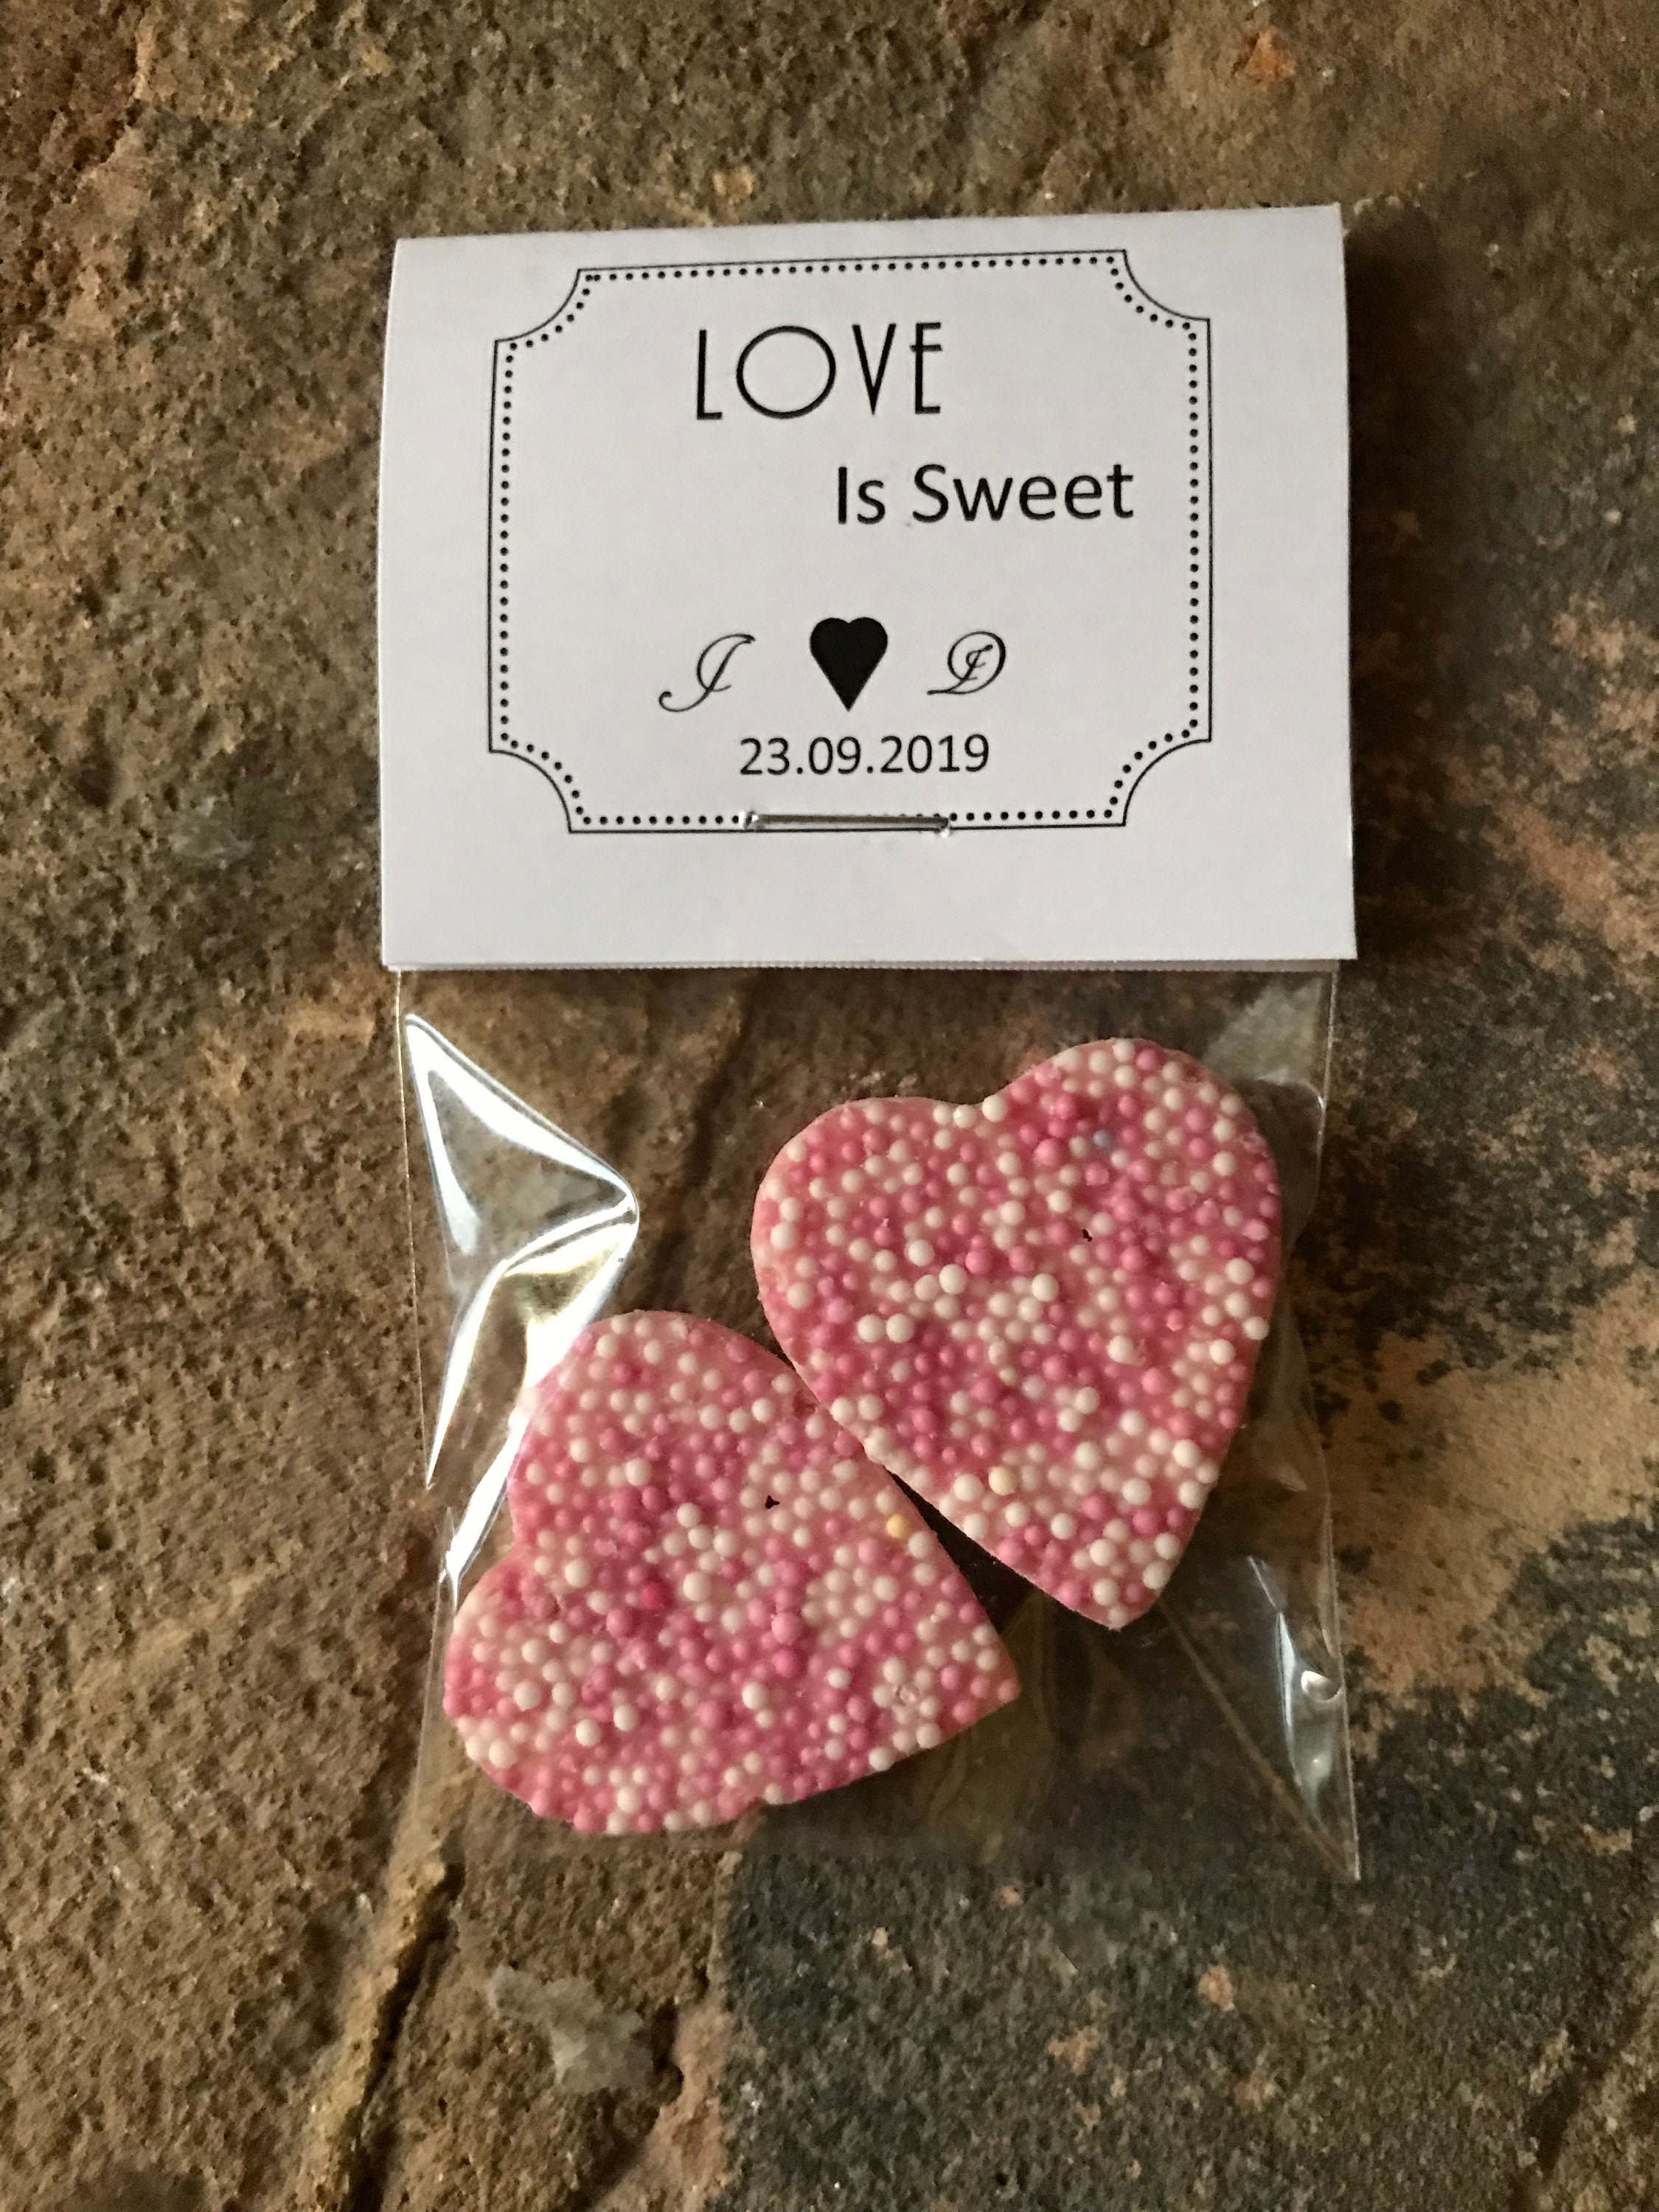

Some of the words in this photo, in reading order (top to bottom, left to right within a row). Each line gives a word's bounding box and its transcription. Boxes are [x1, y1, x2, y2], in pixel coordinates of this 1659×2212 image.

[695, 320, 944, 421] LOVE
[837, 465, 887, 526] Is
[911, 463, 1135, 524] Sweet
[926, 630, 1007, 696] D
[739, 733, 990, 776] 23.09.2019
